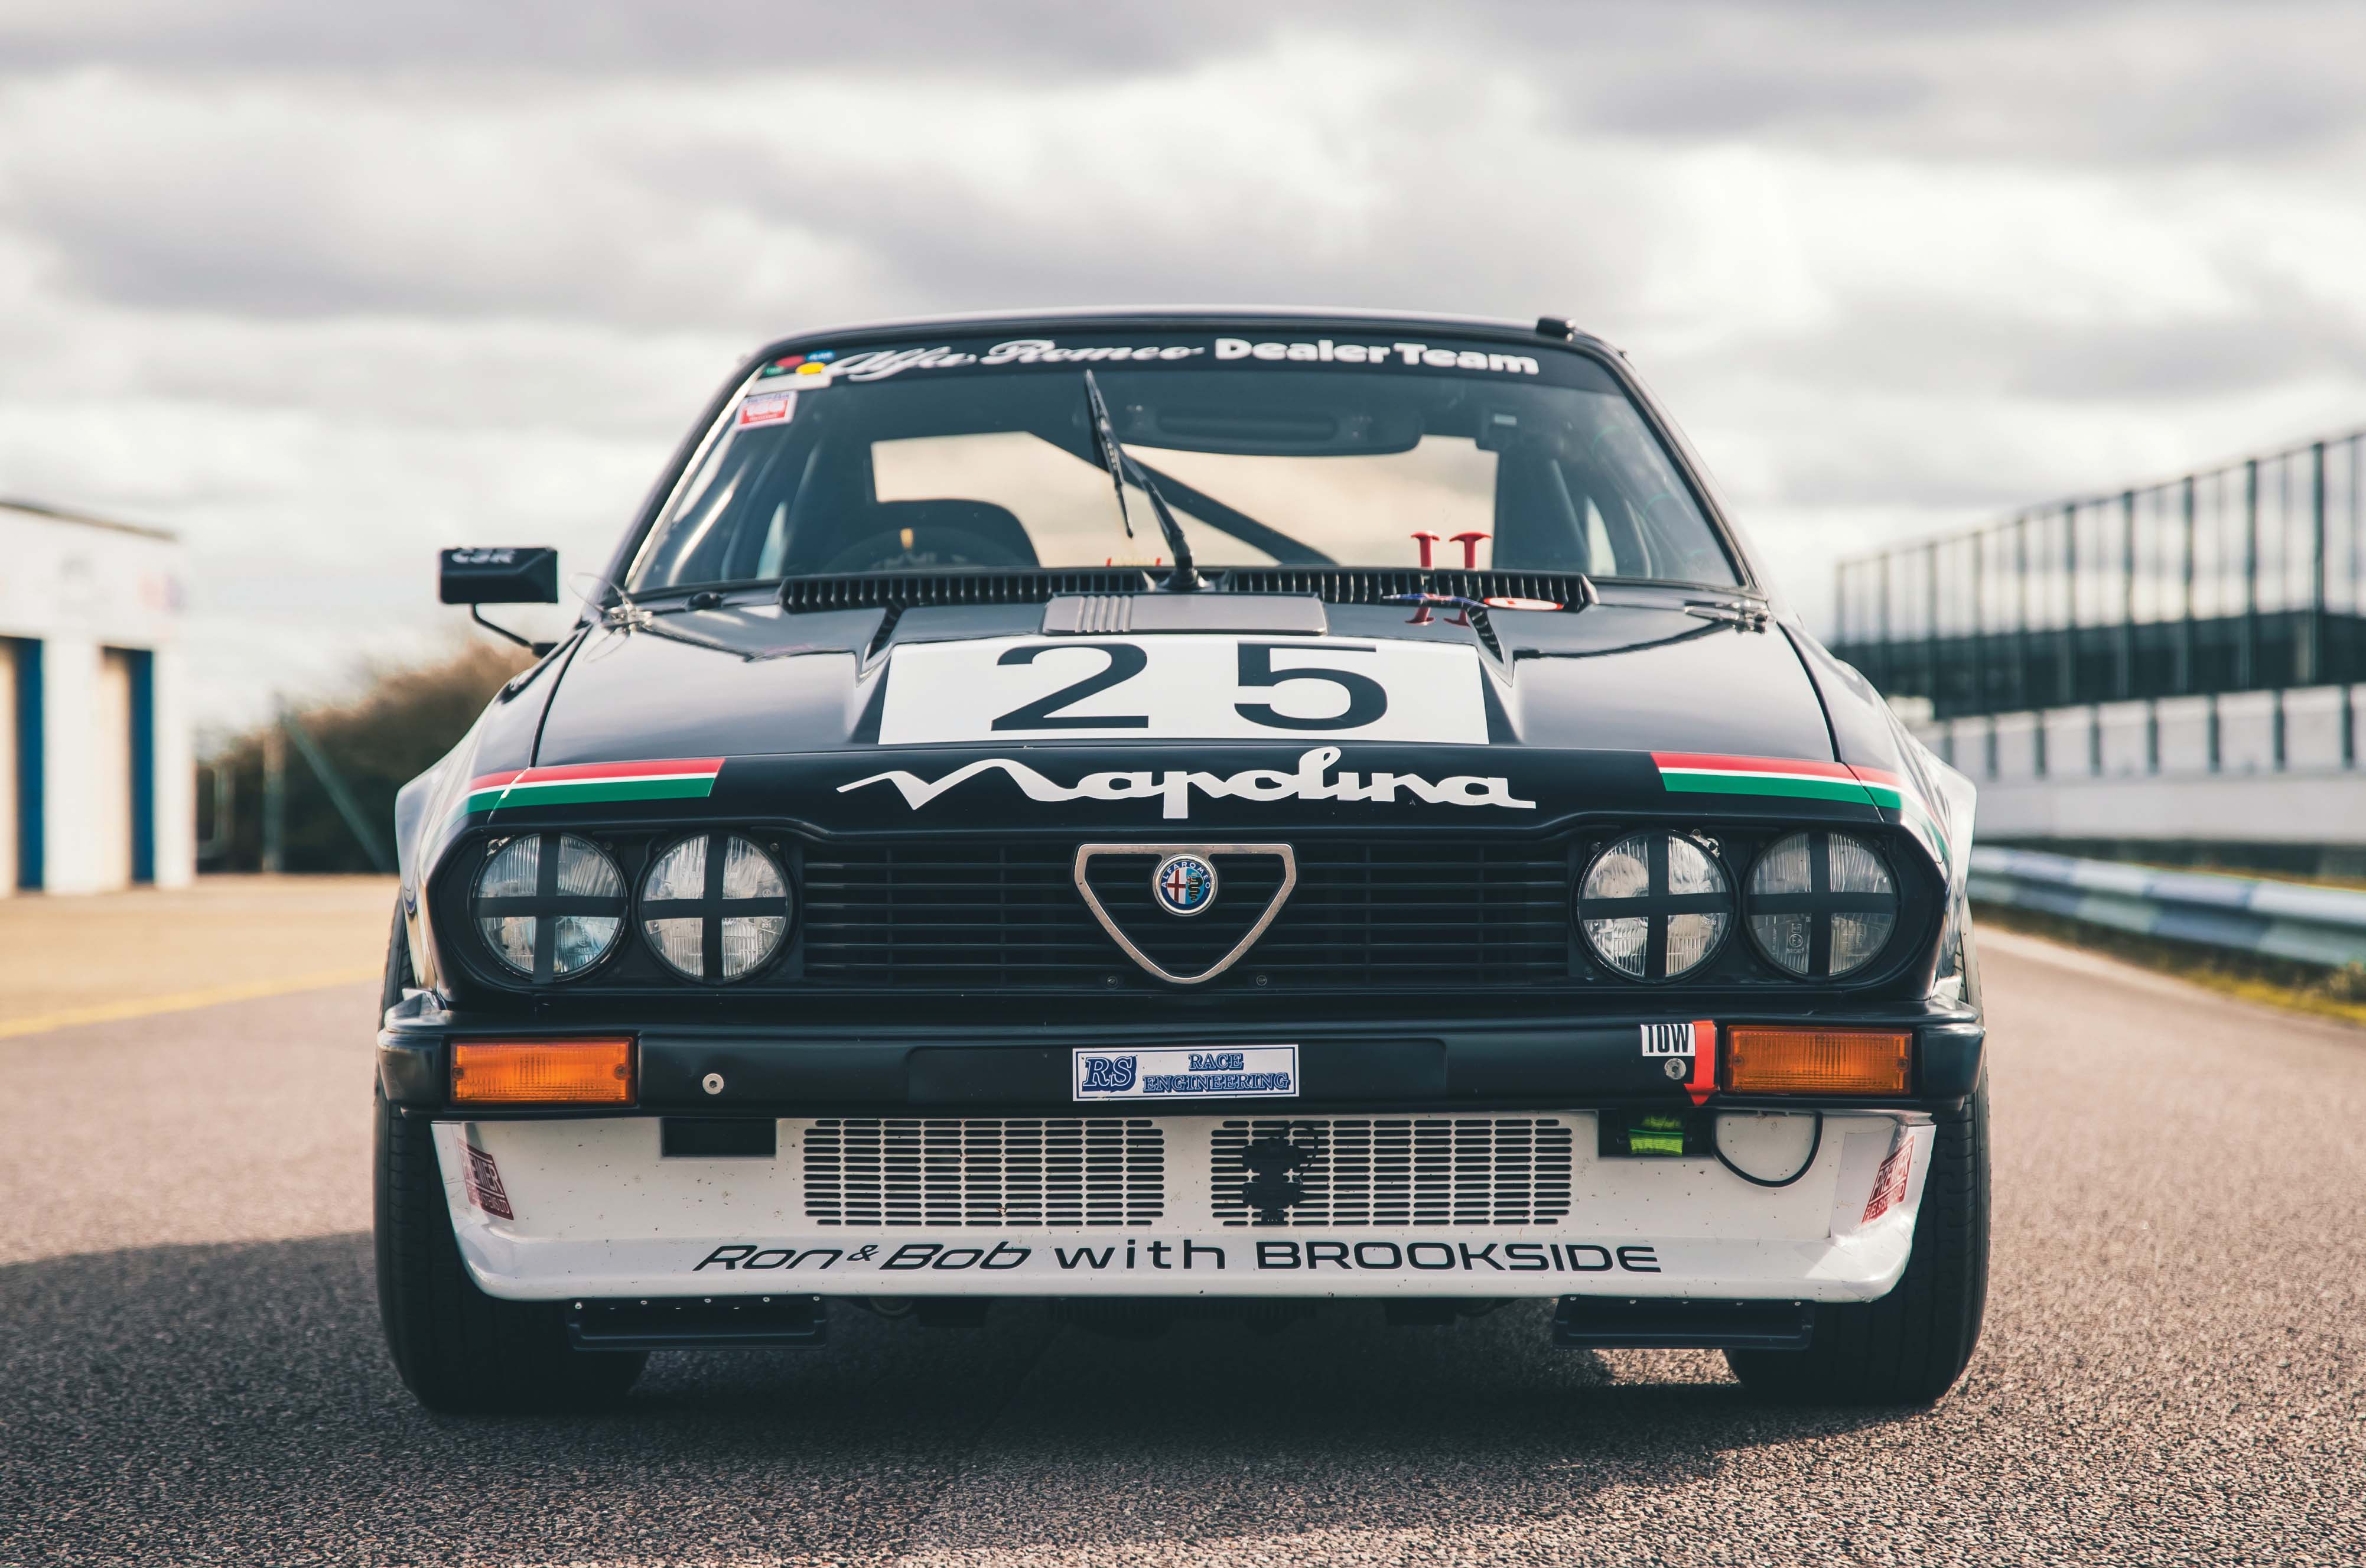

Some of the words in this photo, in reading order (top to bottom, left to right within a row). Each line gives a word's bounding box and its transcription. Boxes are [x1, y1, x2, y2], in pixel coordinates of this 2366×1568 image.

[827, 346, 977, 380] Alfa
[980, 339, 1204, 365] Romeo
[1215, 338, 1391, 363] Dealer
[1394, 343, 1540, 375] Team
[837, 746, 1537, 819] Napolina
[1644, 1024, 1689, 1053] TOW
[1082, 1055, 1137, 1092] RS
[1188, 1053, 1244, 1071] RACE
[1143, 1072, 1291, 1093] ENGINEERING
[693, 1245, 844, 1271] Ron
[878, 1241, 1031, 1270] Bob
[1055, 1239, 1225, 1270] with
[1255, 1241, 1661, 1273] BROOKSIDE
